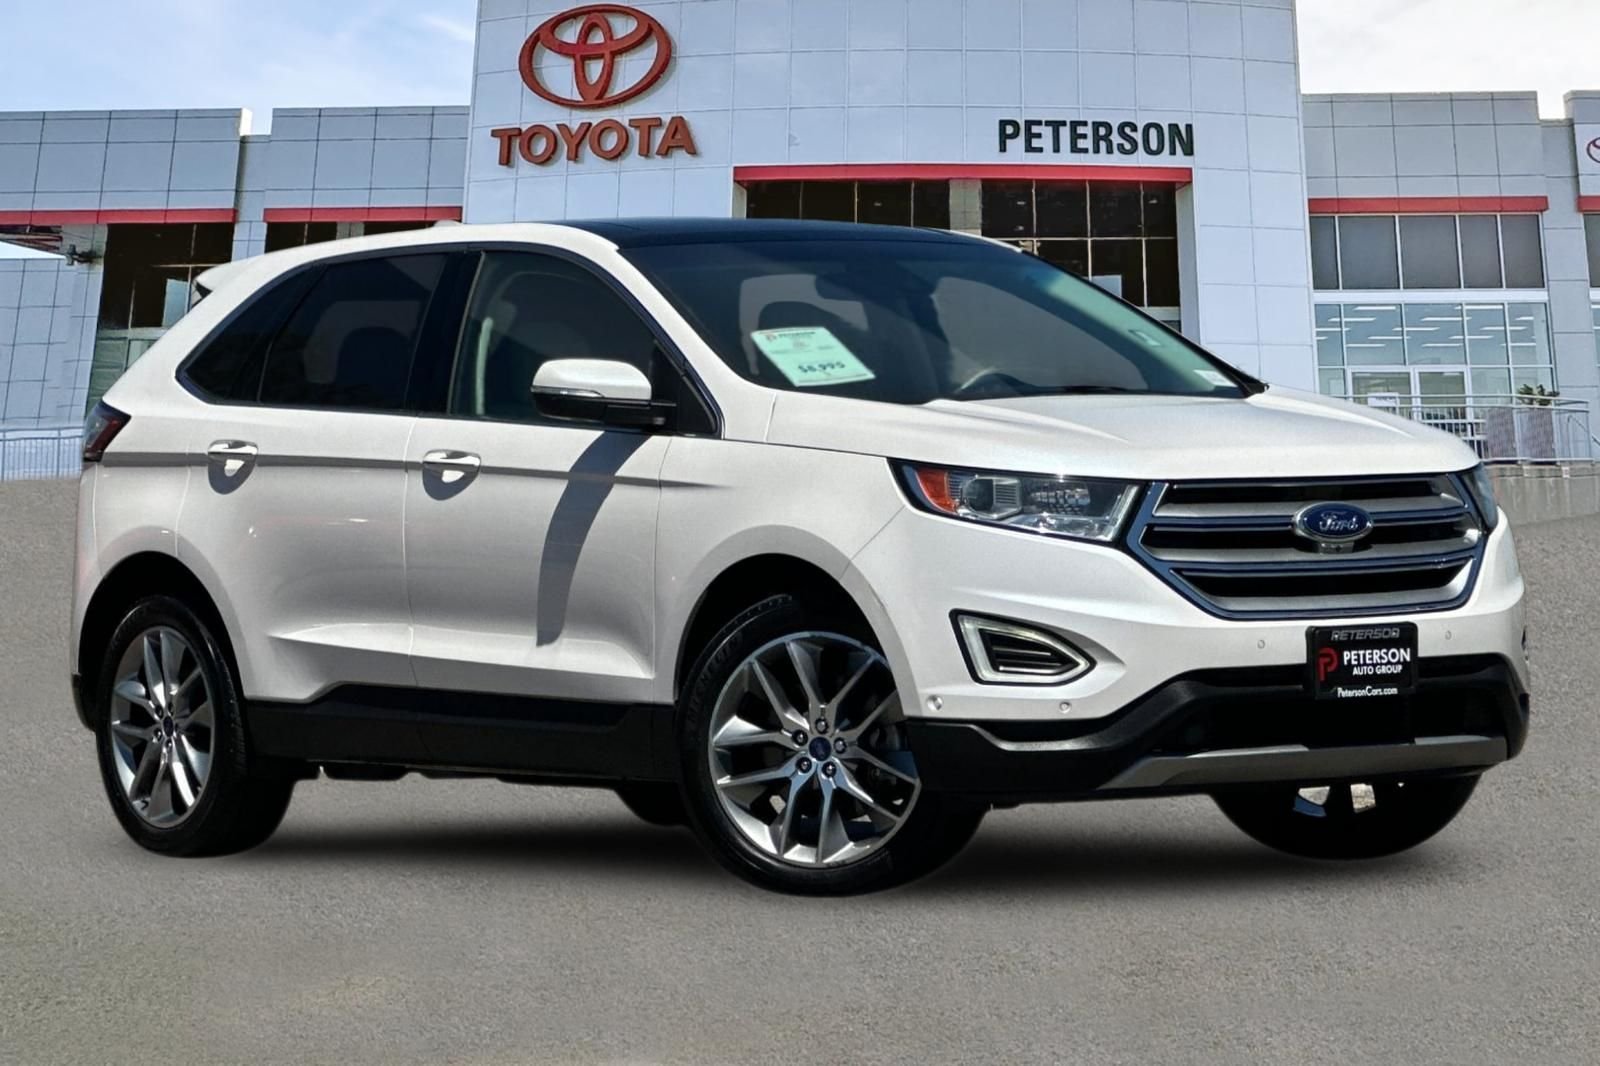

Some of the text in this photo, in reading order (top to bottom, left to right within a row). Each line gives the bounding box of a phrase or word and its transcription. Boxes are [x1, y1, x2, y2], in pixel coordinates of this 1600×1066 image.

[491, 116, 696, 166] TOYOTA
[998, 119, 1194, 156] PETERSON
[1319, 511, 1359, 531] Ford
[1343, 648, 1411, 666] PETERSON
[1352, 664, 1403, 676] AUTO GROUP
[1337, 685, 1399, 698] PetersonCars.com
